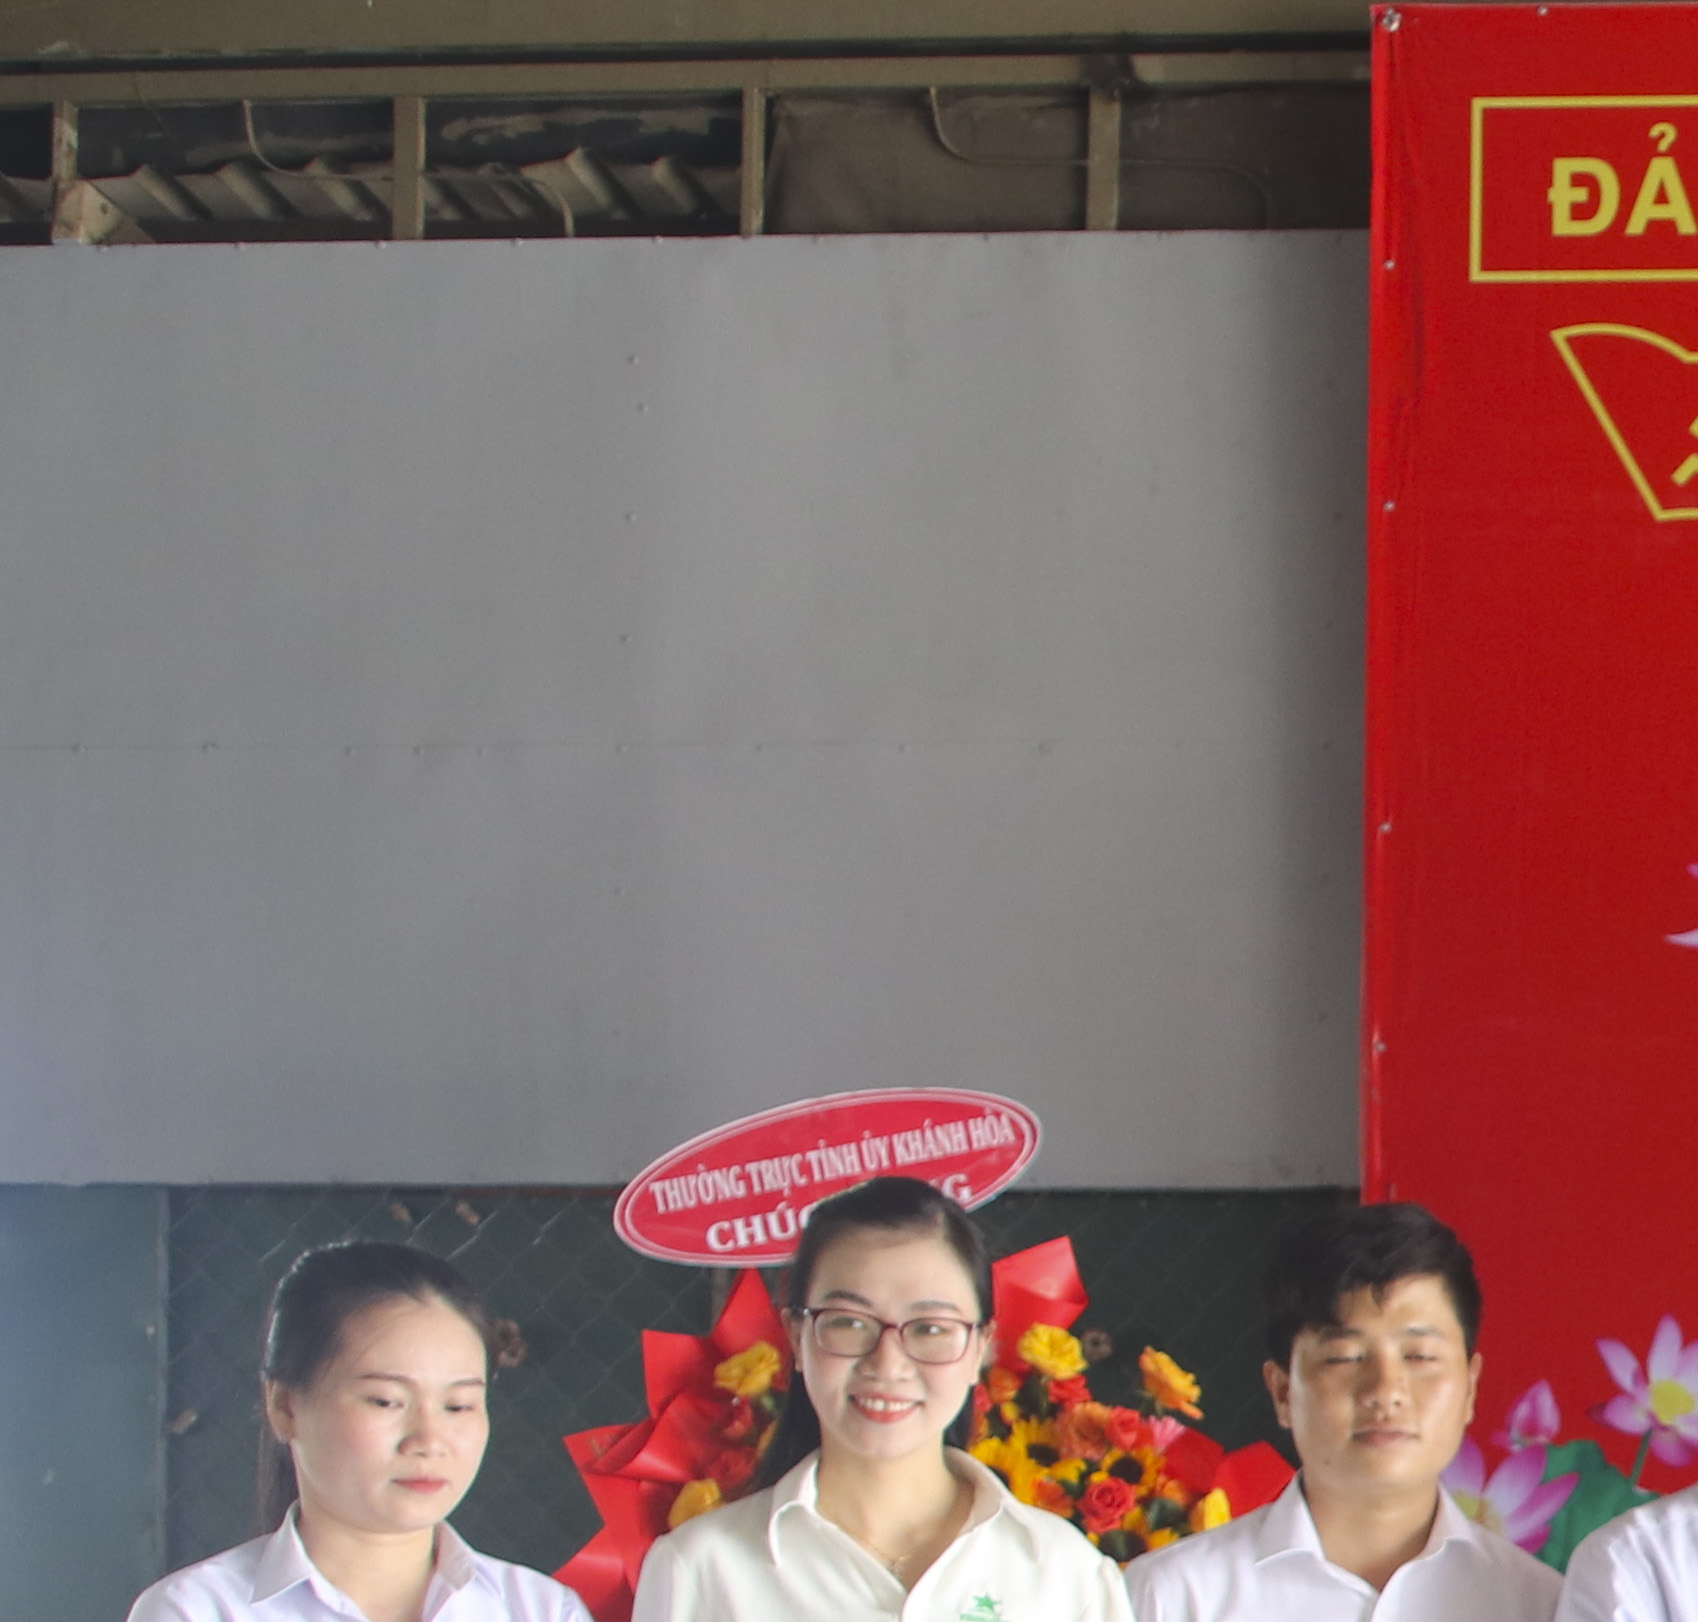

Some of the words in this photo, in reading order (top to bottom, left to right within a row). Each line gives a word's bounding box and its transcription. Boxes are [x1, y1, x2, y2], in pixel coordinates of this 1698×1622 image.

[648, 1162, 747, 1215] THƯỜNG
[744, 1152, 809, 1197] TRỰC
[805, 1138, 863, 1184] TỈNH
[891, 1117, 970, 1167] KHÁNH
